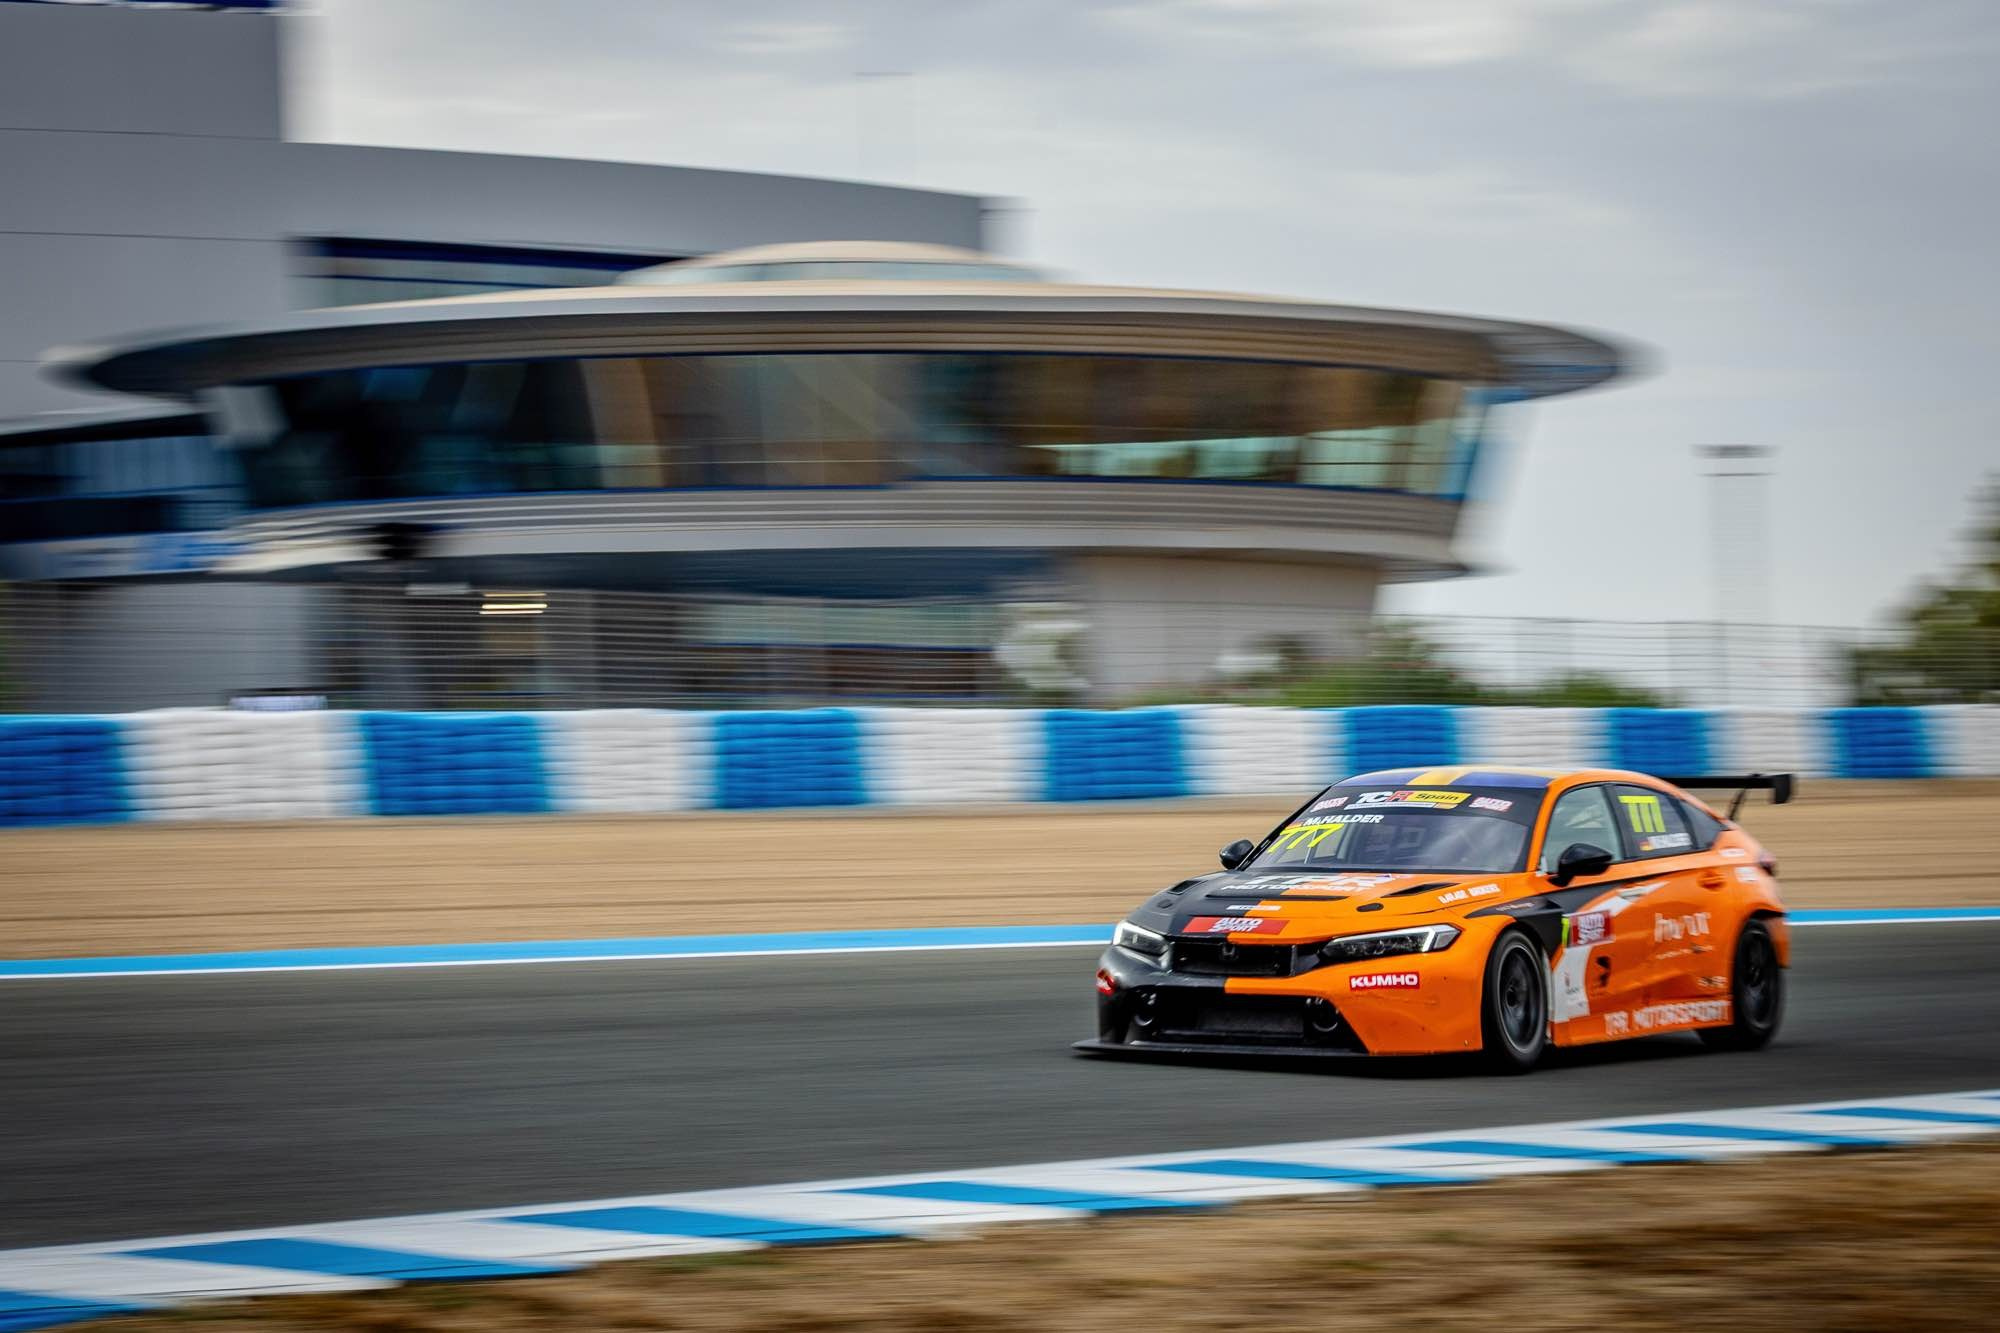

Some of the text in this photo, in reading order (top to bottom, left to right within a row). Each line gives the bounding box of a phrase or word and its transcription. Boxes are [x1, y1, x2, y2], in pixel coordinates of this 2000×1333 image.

[1353, 791, 1414, 806] TCR
[1415, 793, 1460, 802] Spain
[1617, 795, 1666, 833] 777
[1267, 823, 1344, 854] 777
[1208, 923, 1258, 932] SPORT
[1217, 918, 1264, 927] AUTO
[1350, 973, 1418, 988] KUMHO
